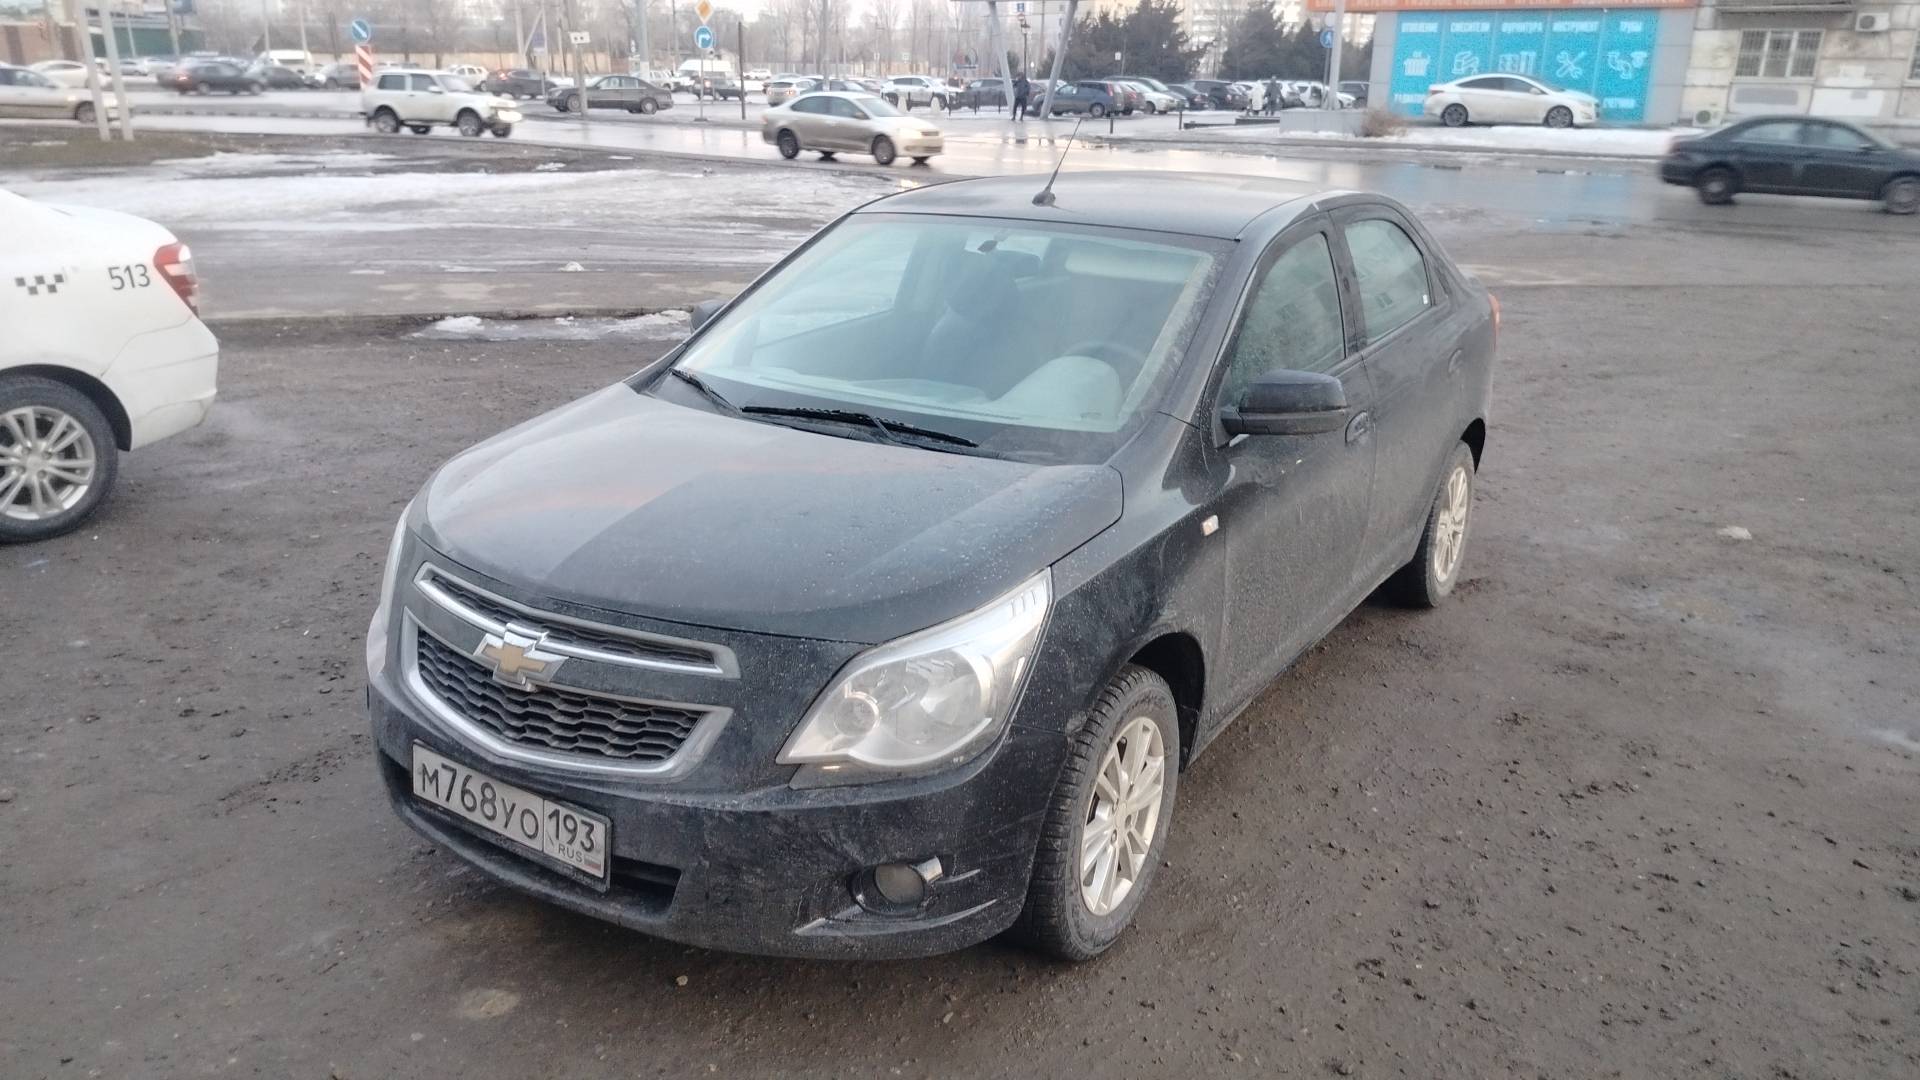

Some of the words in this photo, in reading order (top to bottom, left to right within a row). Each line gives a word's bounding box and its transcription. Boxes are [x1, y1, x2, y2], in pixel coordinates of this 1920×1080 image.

[108, 263, 151, 291] 513
[547, 808, 596, 853] 193
[558, 843, 584, 863] RUS
